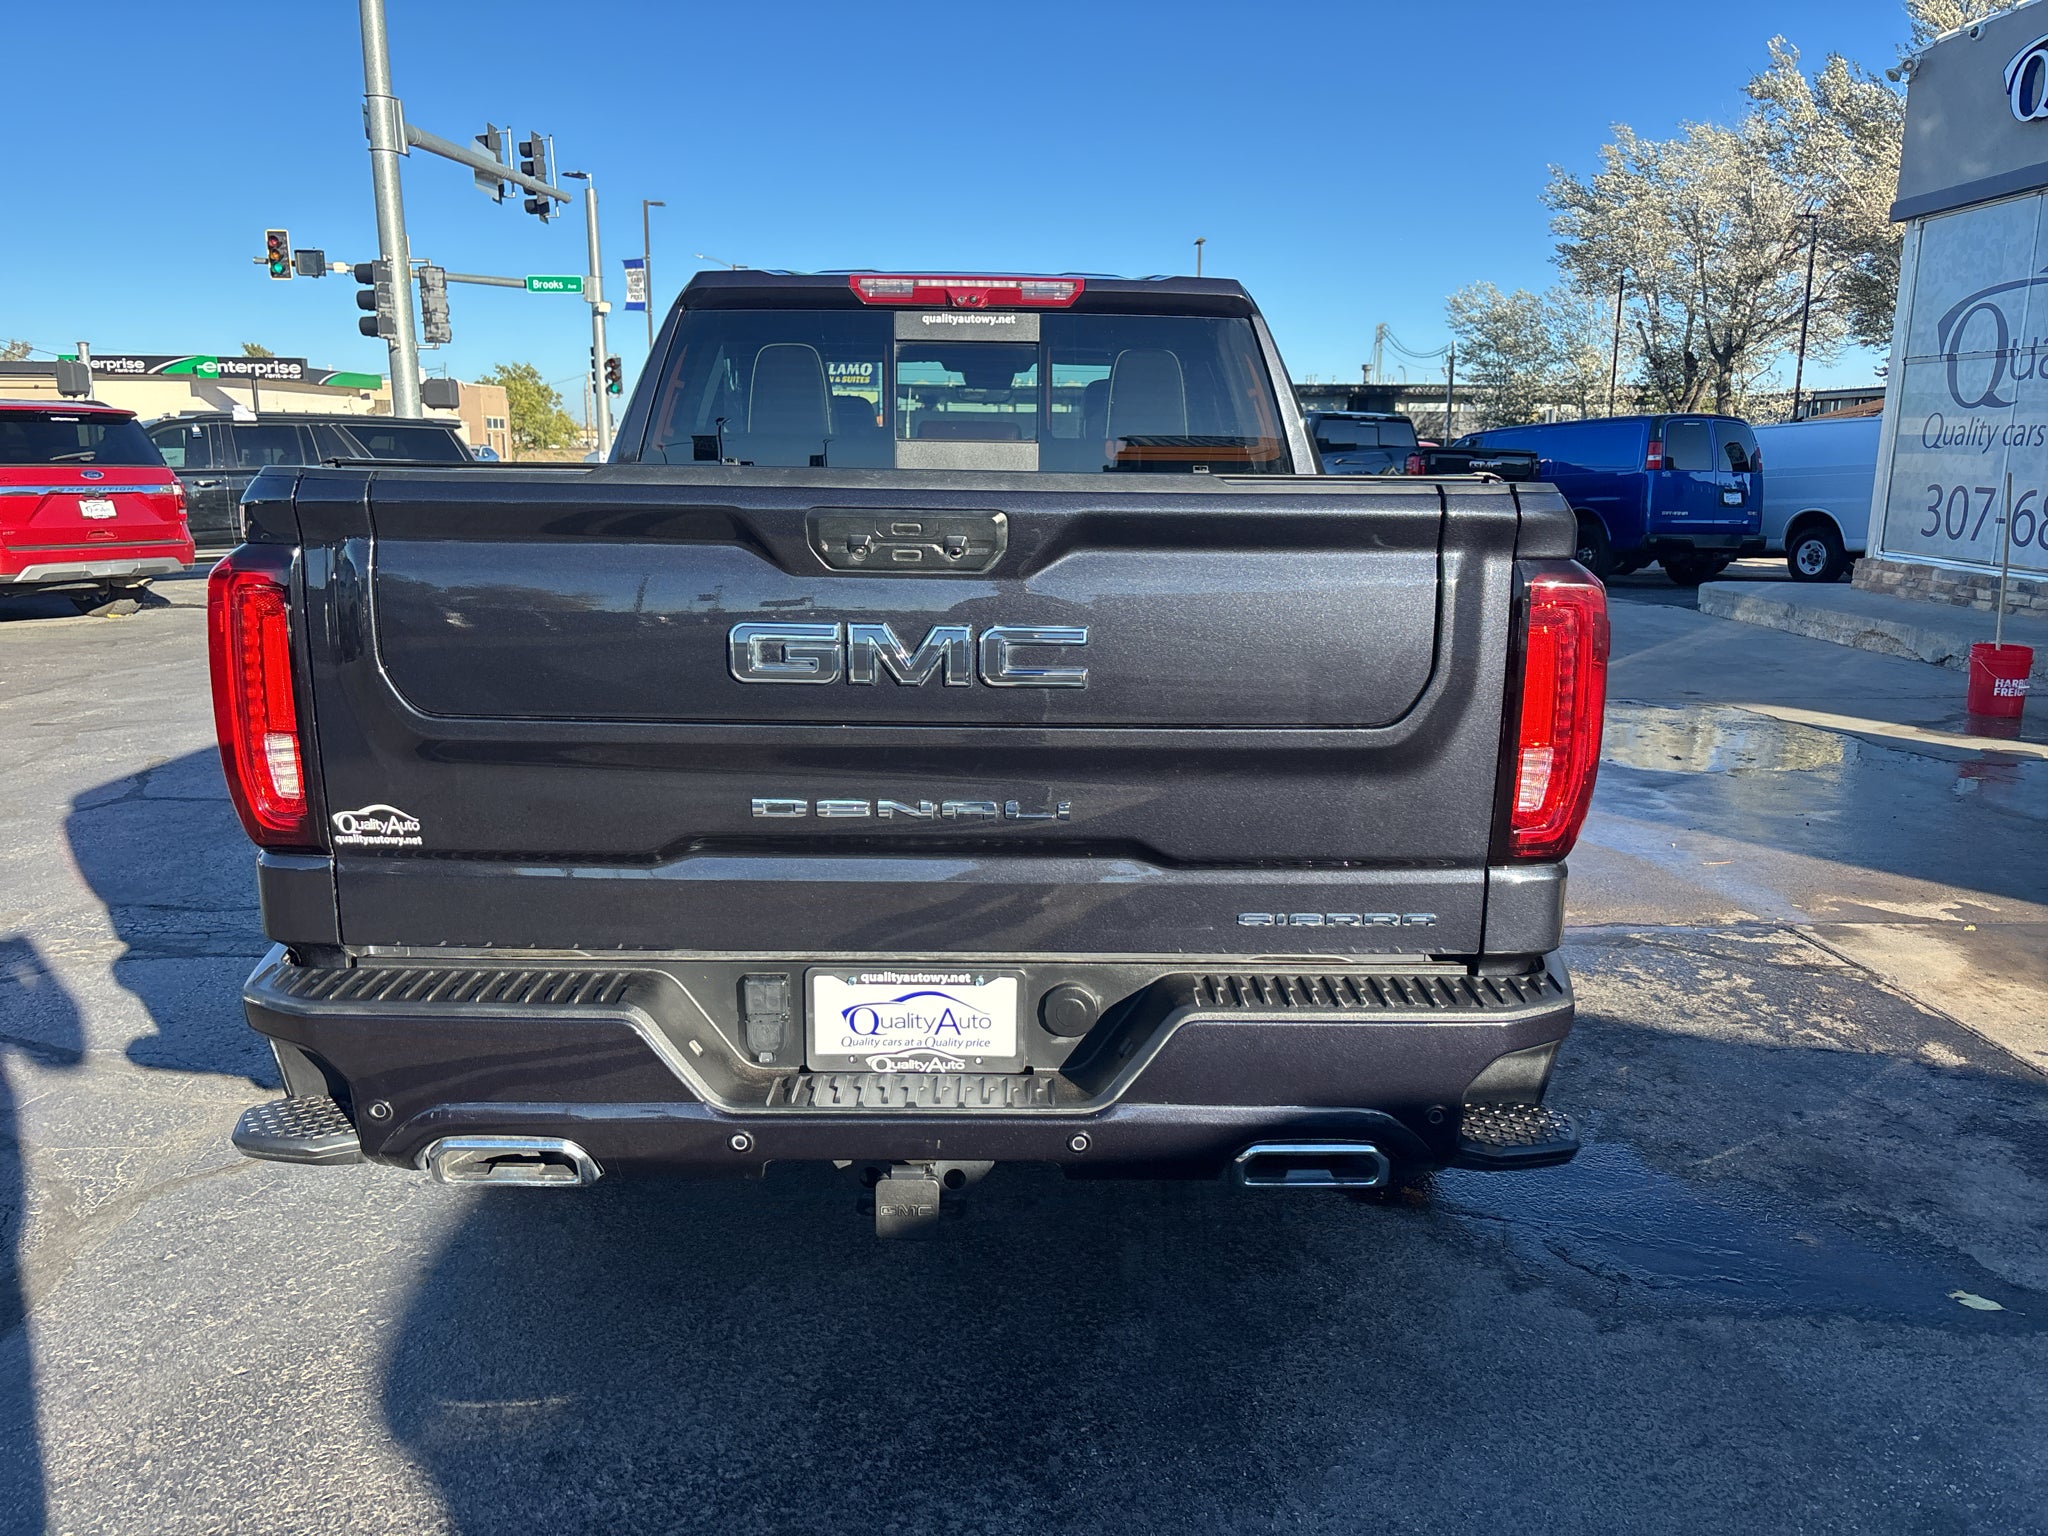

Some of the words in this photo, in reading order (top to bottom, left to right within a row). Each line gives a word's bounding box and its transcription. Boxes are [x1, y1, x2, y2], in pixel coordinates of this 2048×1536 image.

[532, 279, 564, 289] Brooks
[922, 313, 1016, 326] qualityautowy.net
[90, 357, 145, 372] erprise
[114, 366, 146, 374] rent-a-car
[197, 359, 302, 377] enterprise
[828, 362, 873, 376] LAMO
[841, 375, 871, 384] SUITES
[1922, 412, 1999, 455] Quality
[2002, 423, 2045, 447] cars
[728, 621, 1089, 689] GMC
[1993, 687, 2026, 697] FREIG
[752, 798, 1072, 820] DENALI
[334, 834, 423, 846] qualityautowy.net
[1237, 912, 1437, 927] SIERRA
[860, 972, 971, 985] qualityautowy.net
[841, 1036, 880, 1048] Quality
[882, 1038, 903, 1047] cars
[904, 1039, 915, 1047] at
[924, 1036, 964, 1048] Quality
[965, 1038, 991, 1049] price
[880, 1204, 934, 1216] GMC
